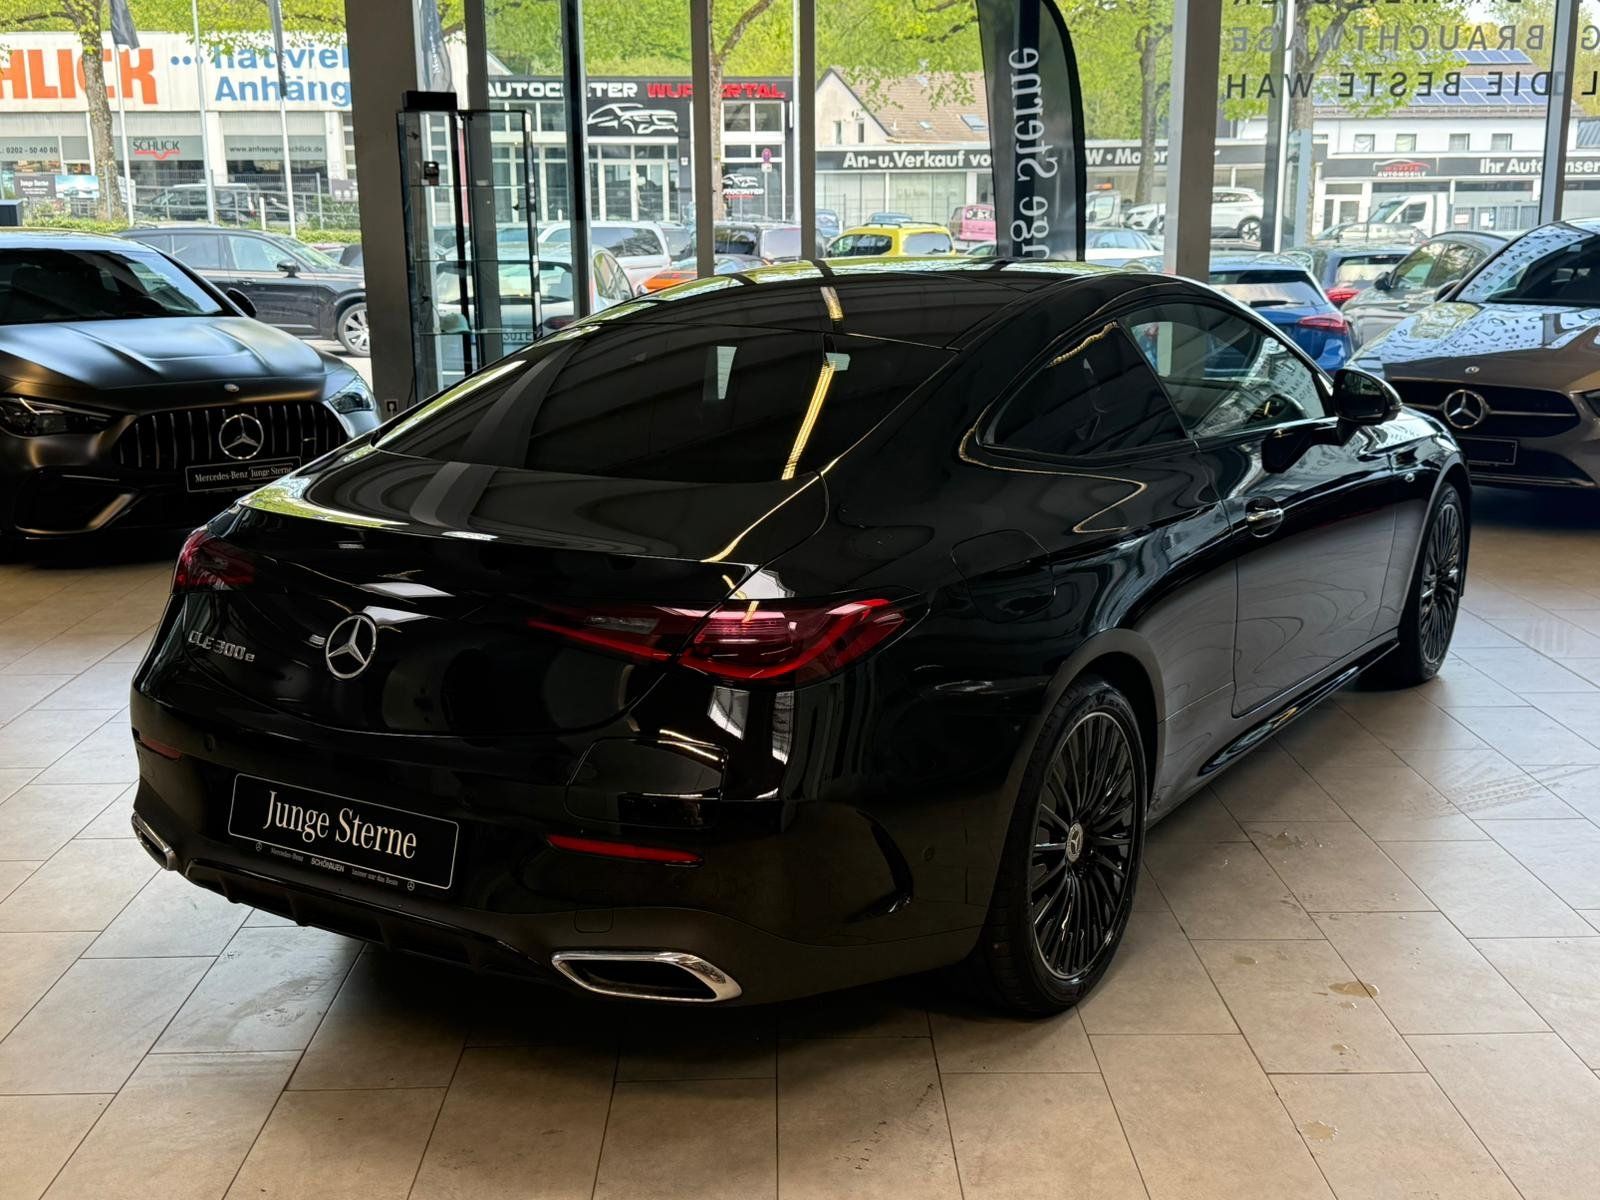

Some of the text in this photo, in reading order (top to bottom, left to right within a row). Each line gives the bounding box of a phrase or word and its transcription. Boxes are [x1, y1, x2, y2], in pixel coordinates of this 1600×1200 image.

[487, 82, 638, 98] AUTOCTER
[133, 140, 180, 151] SCHLICK
[1479, 158, 1504, 174] Ihr
[1565, 160, 1600, 174] nser
[194, 465, 293, 484] Mercedes-Benz Junge Sterne
[188, 629, 214, 650] CLE
[263, 790, 417, 859] Junge Sterne
